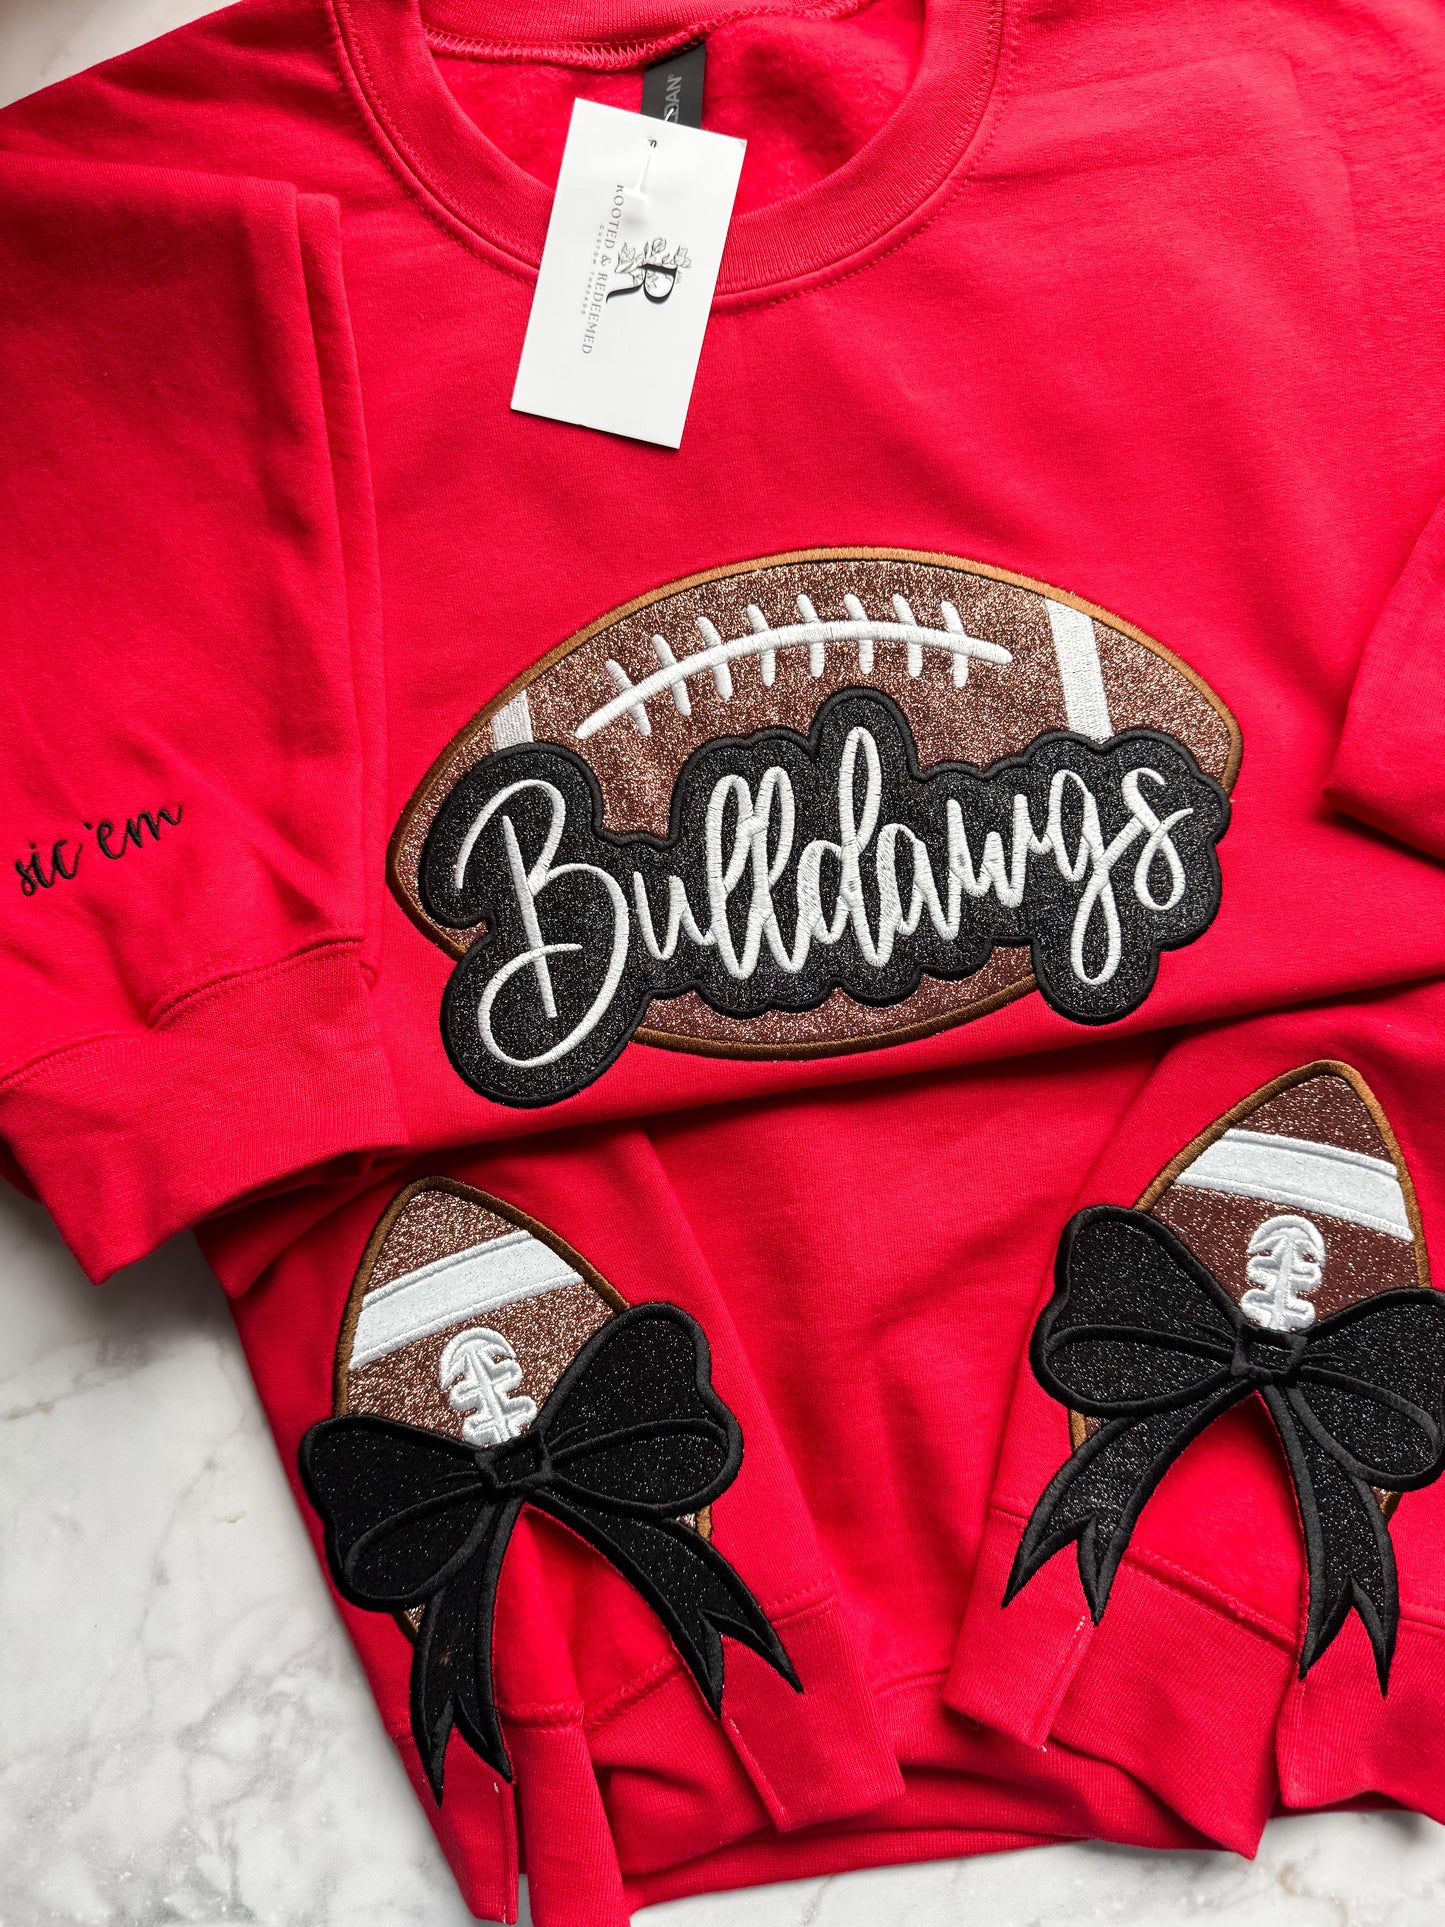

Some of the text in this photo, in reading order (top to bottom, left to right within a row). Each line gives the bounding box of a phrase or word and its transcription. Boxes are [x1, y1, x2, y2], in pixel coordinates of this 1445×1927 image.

[580, 224, 605, 316] CUSTOM THREADS
[600, 254, 612, 267] &
[605, 262, 678, 305] R
[581, 271, 608, 355] REDEEMED
[14, 839, 84, 897] sic
[451, 726, 1196, 1069] Bulldawgs
